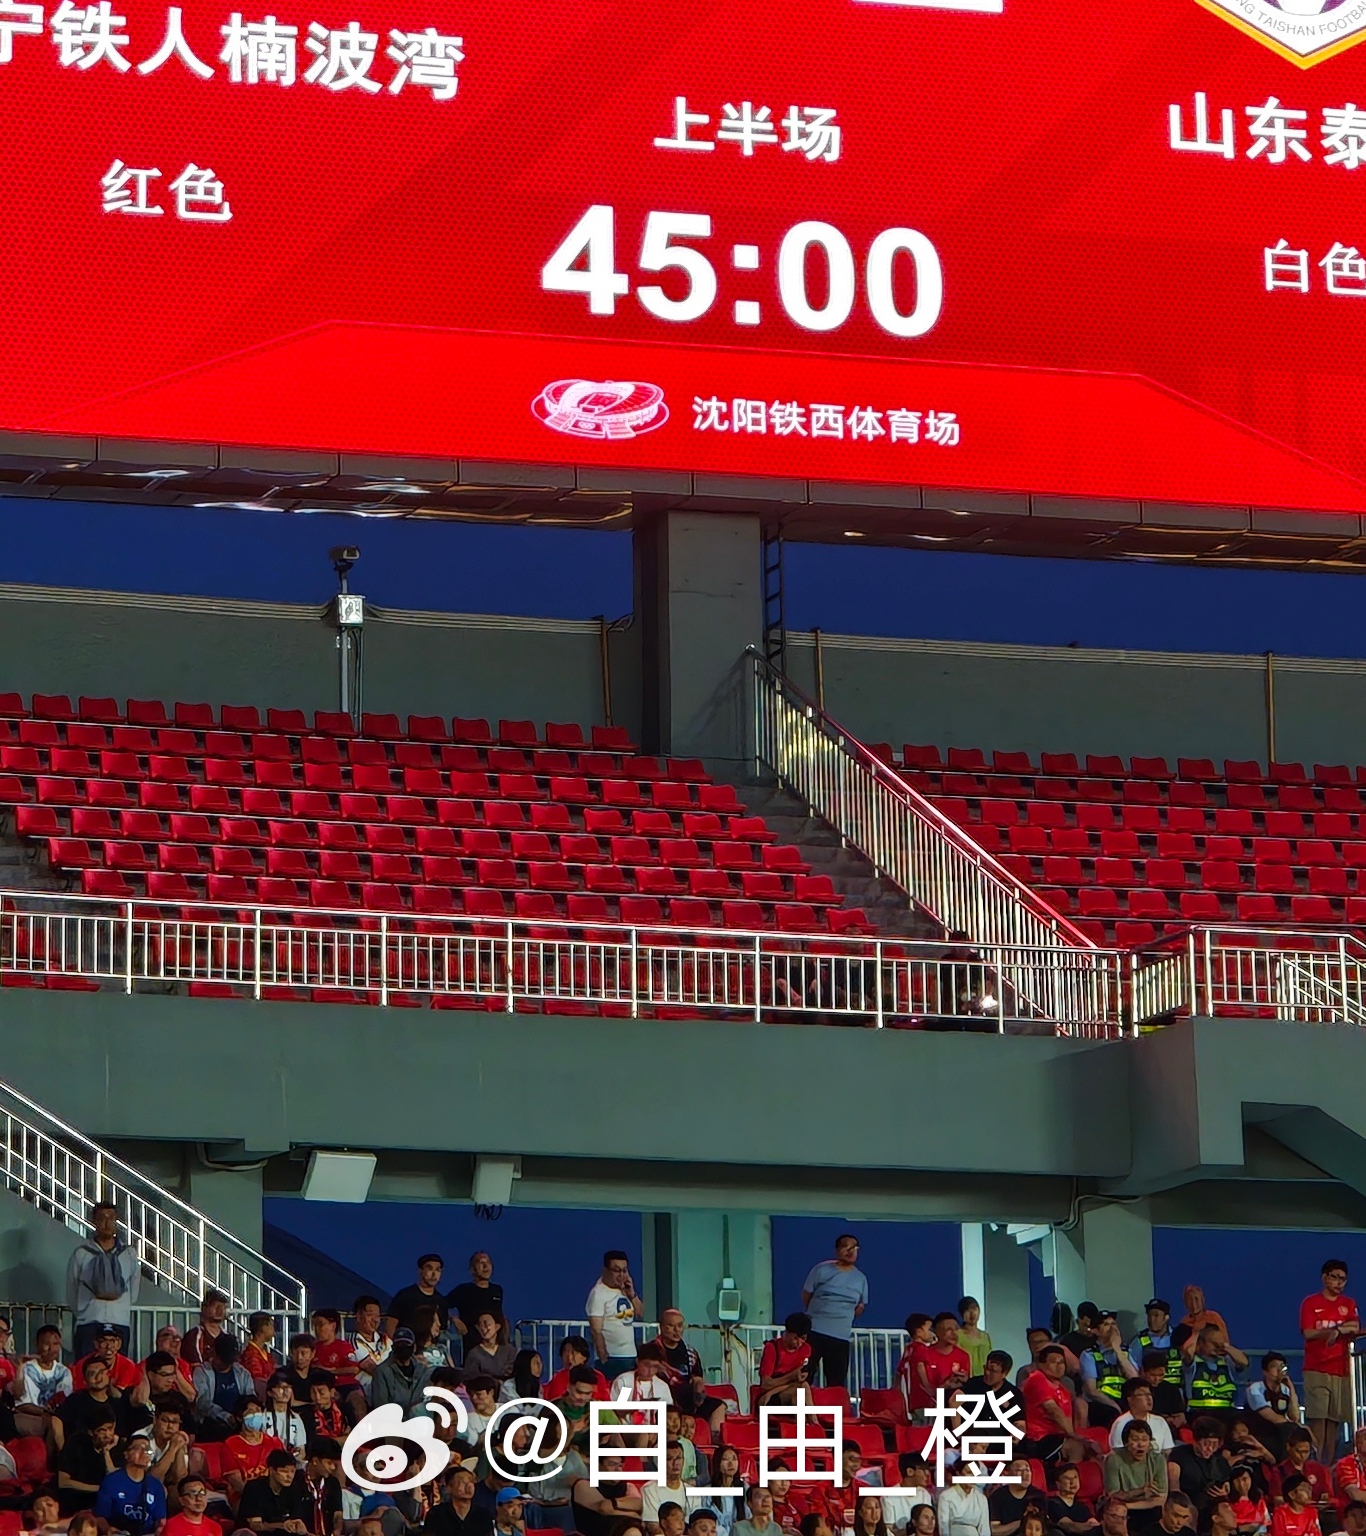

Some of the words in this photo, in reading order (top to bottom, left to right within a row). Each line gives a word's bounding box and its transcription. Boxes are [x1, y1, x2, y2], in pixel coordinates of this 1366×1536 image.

[1257, 11, 1316, 37] TAISHAN
[653, 95, 842, 163] 上半场
[100, 158, 234, 223] 红色
[541, 204, 943, 338] 45:00
[691, 395, 961, 446] 沈阳铁西体育场
